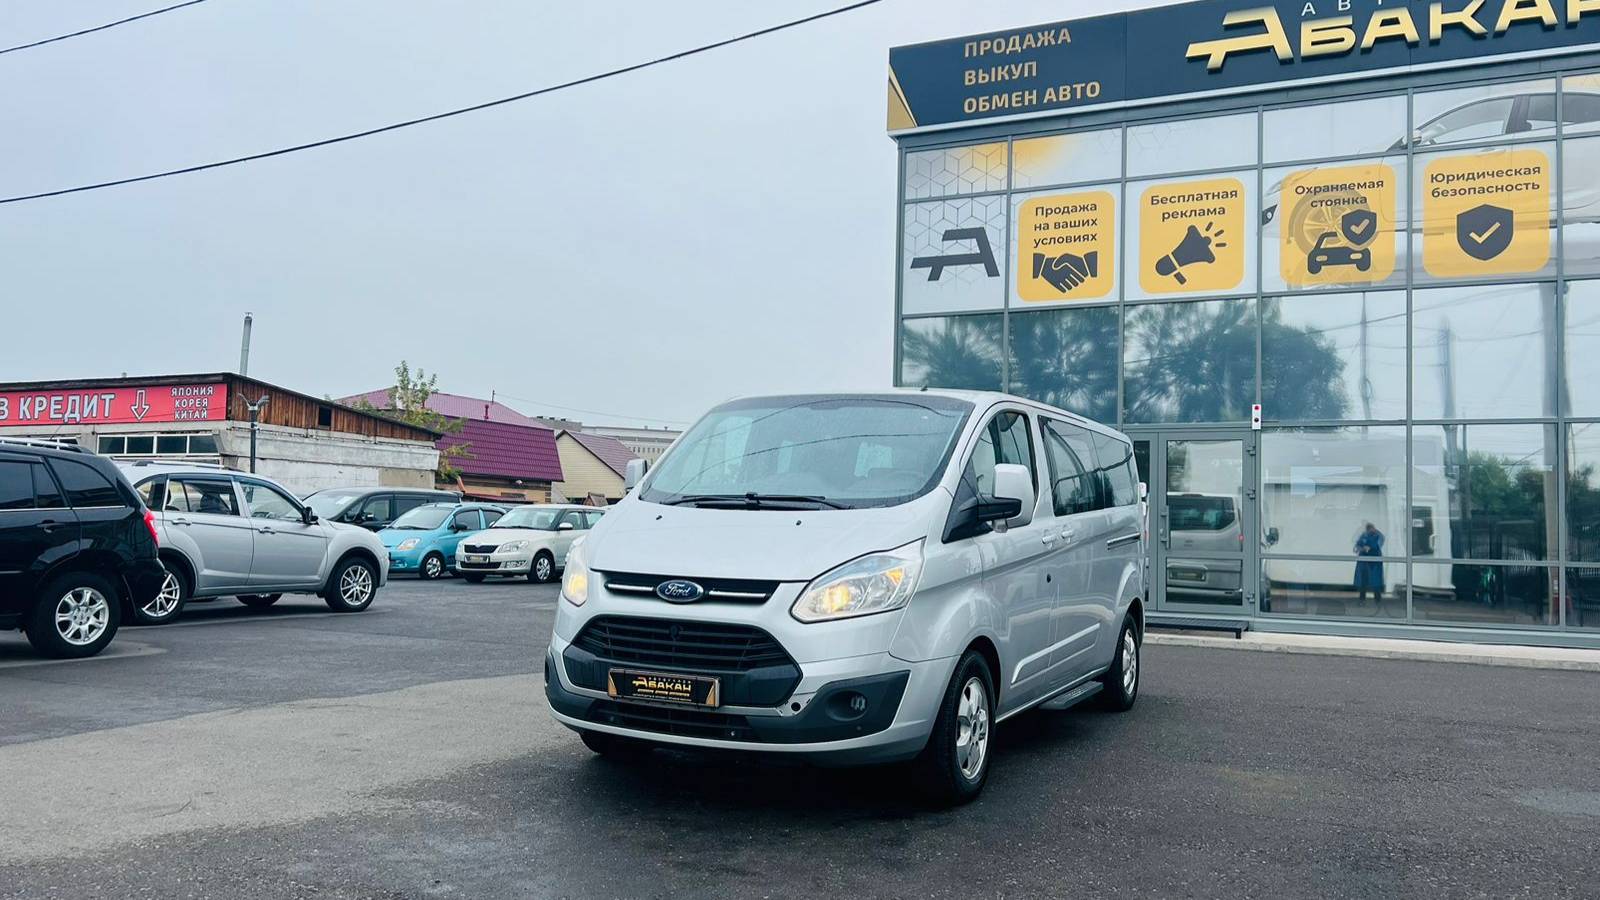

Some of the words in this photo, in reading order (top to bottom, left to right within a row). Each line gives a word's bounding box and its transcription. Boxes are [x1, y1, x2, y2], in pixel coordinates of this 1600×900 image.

[964, 28, 1072, 57] ПРОДАЖА
[964, 61, 1037, 86] ВЫКУП
[964, 90, 1037, 114] ОБМЕН
[1043, 81, 1101, 104] АВТО
[1430, 165, 1541, 184] Юридическая
[1294, 179, 1384, 196] Охраняемая
[1431, 181, 1540, 198] безопасность
[1150, 188, 1238, 206] Бесплатная
[1310, 194, 1368, 208] стоянка
[1035, 203, 1097, 218] Продажа
[1161, 205, 1226, 222] реклама
[1034, 222, 1049, 231] на
[1053, 217, 1098, 230] ваших
[1033, 232, 1097, 248] условиях
[171, 386, 213, 397] ЯПОНИЯ
[19, 393, 115, 423] КРЕДИТ
[175, 398, 208, 408] КОРЕЯ
[174, 408, 208, 420] КИТАЙ
[664, 583, 691, 596] Ford
